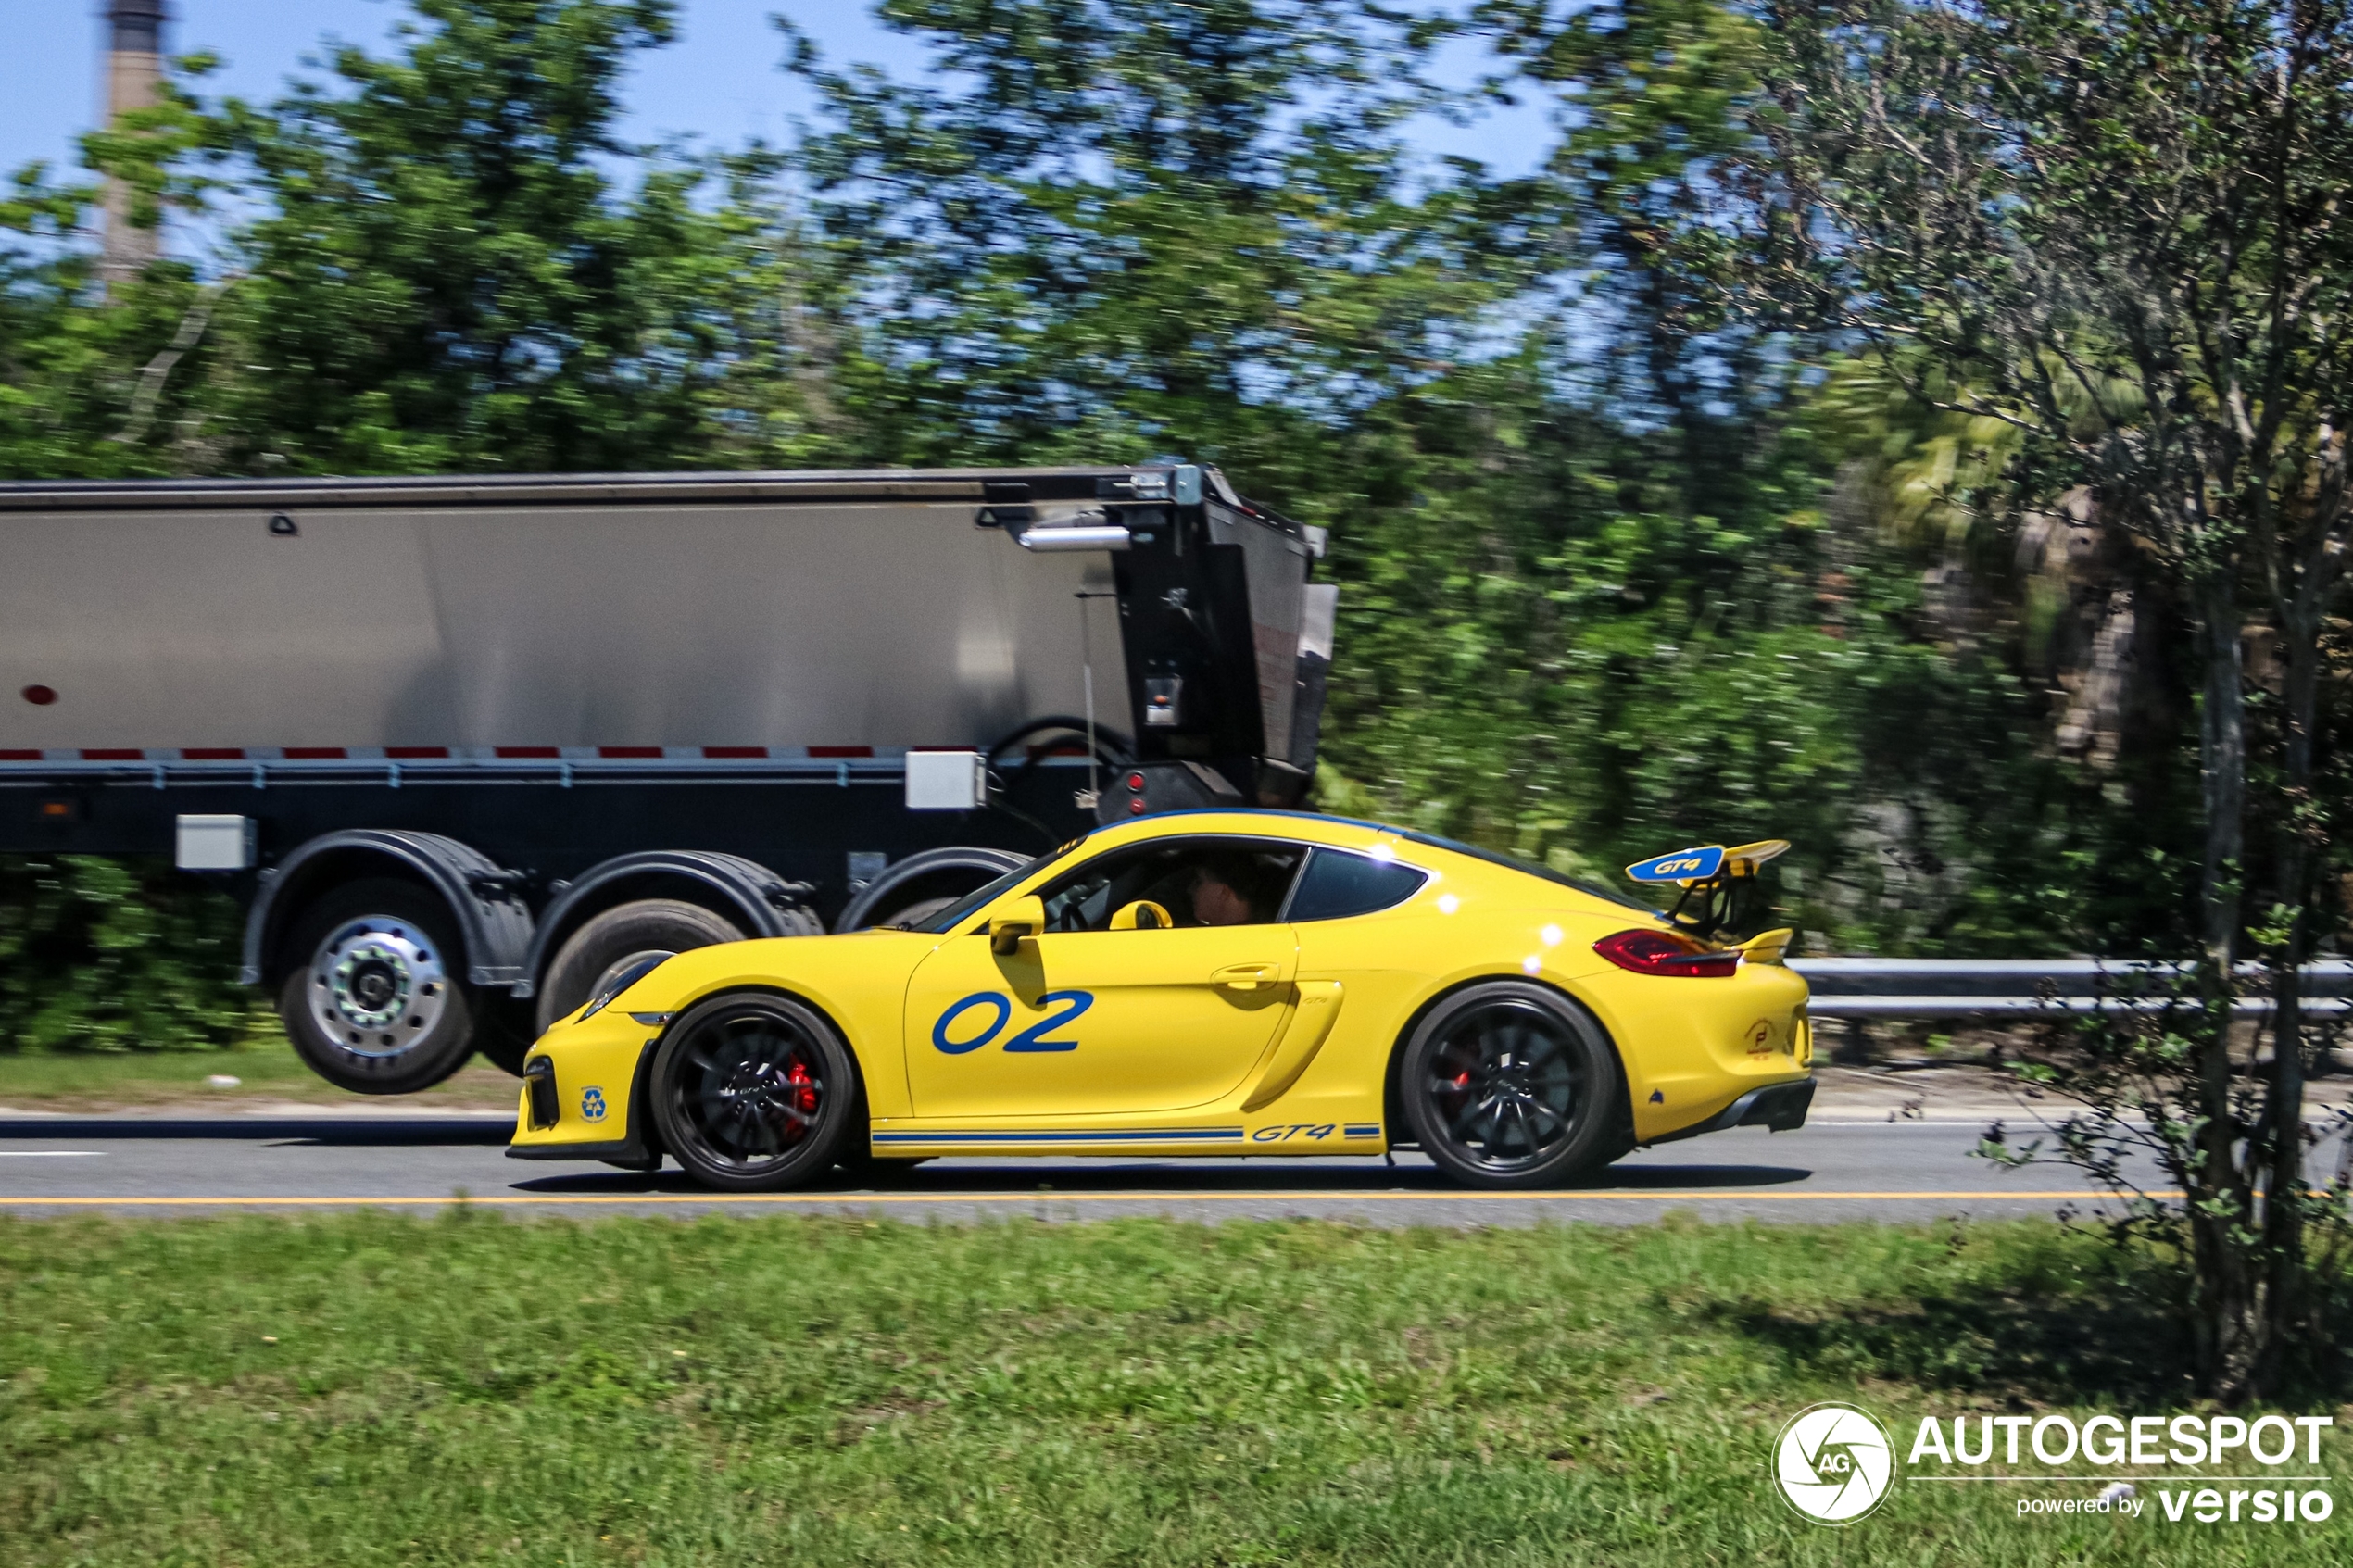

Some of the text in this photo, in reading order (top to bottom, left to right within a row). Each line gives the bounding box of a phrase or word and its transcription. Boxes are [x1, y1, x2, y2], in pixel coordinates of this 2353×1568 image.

[1654, 858, 1702, 874] GT4
[932, 990, 1094, 1054] 02
[1252, 1123, 1336, 1142] GT4
